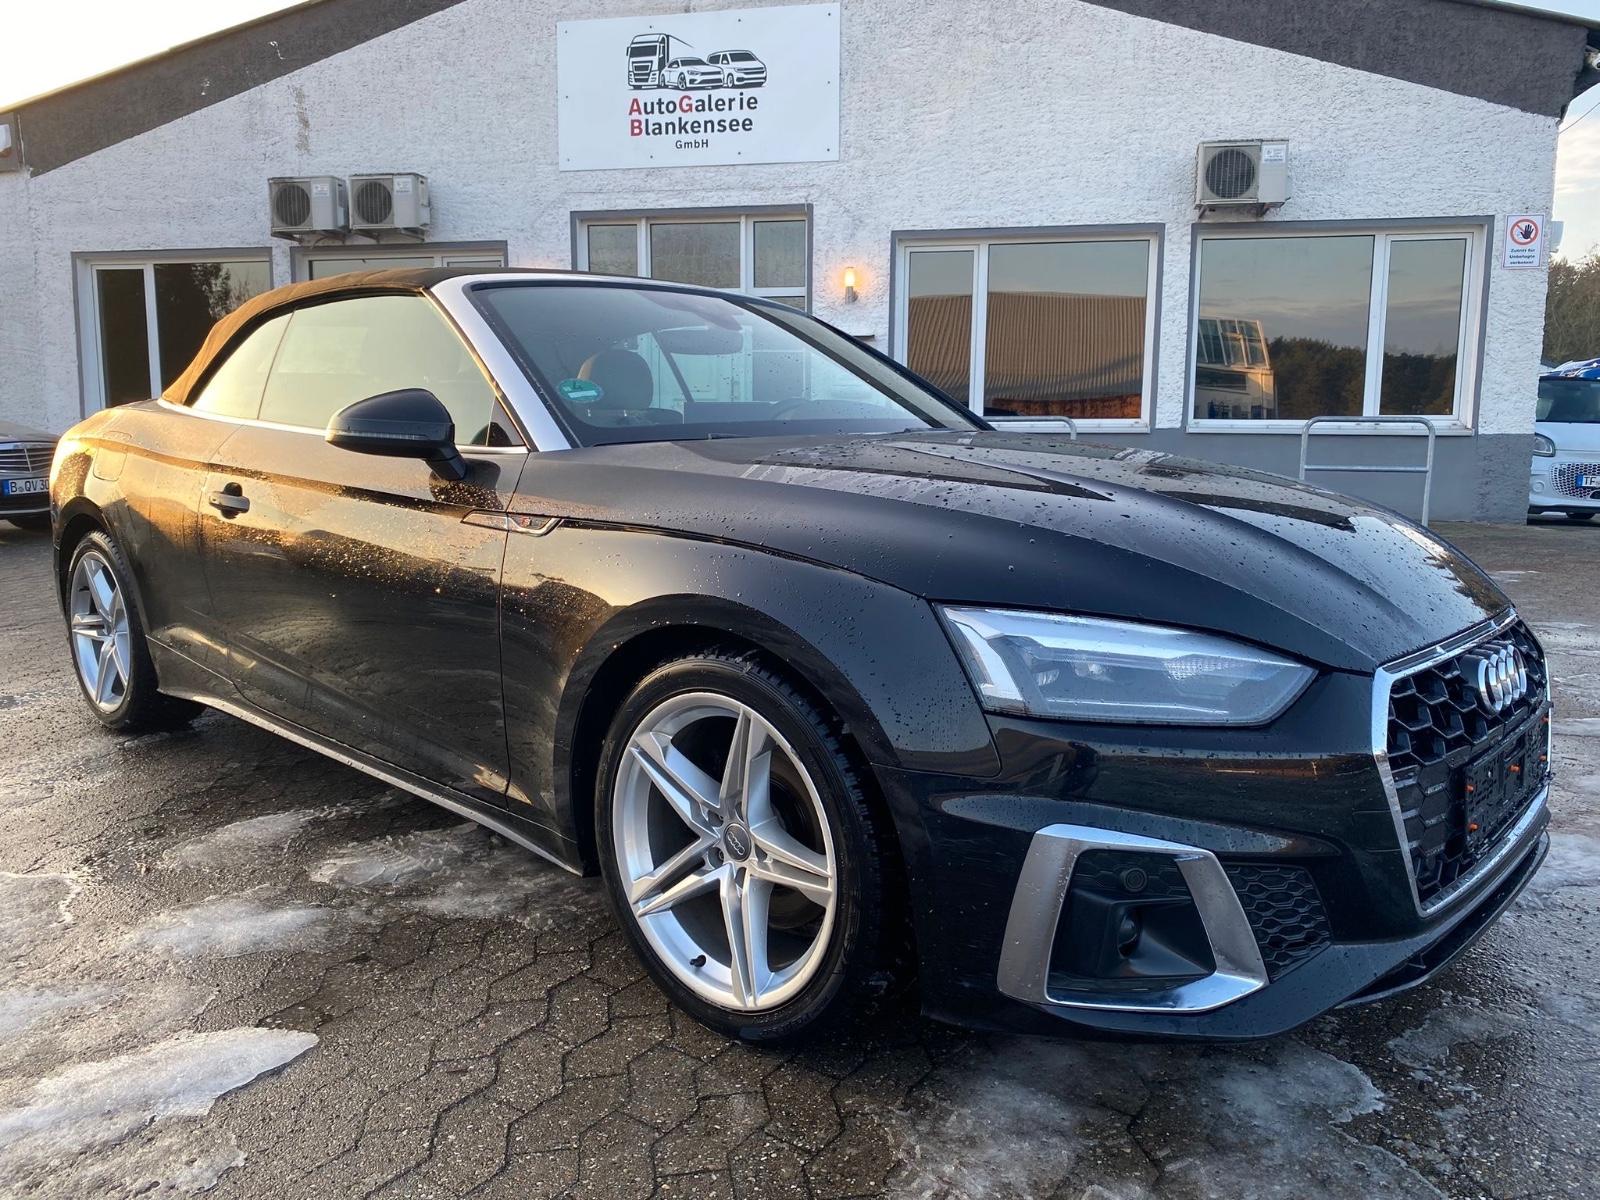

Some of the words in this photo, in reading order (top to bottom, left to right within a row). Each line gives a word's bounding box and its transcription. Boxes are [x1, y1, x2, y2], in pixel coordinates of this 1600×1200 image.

[628, 91, 759, 116] AutoGalerie
[629, 116, 754, 137] Blankensee
[675, 139, 709, 150] GmbH
[10, 481, 18, 493] B
[1584, 476, 1597, 486] TF
